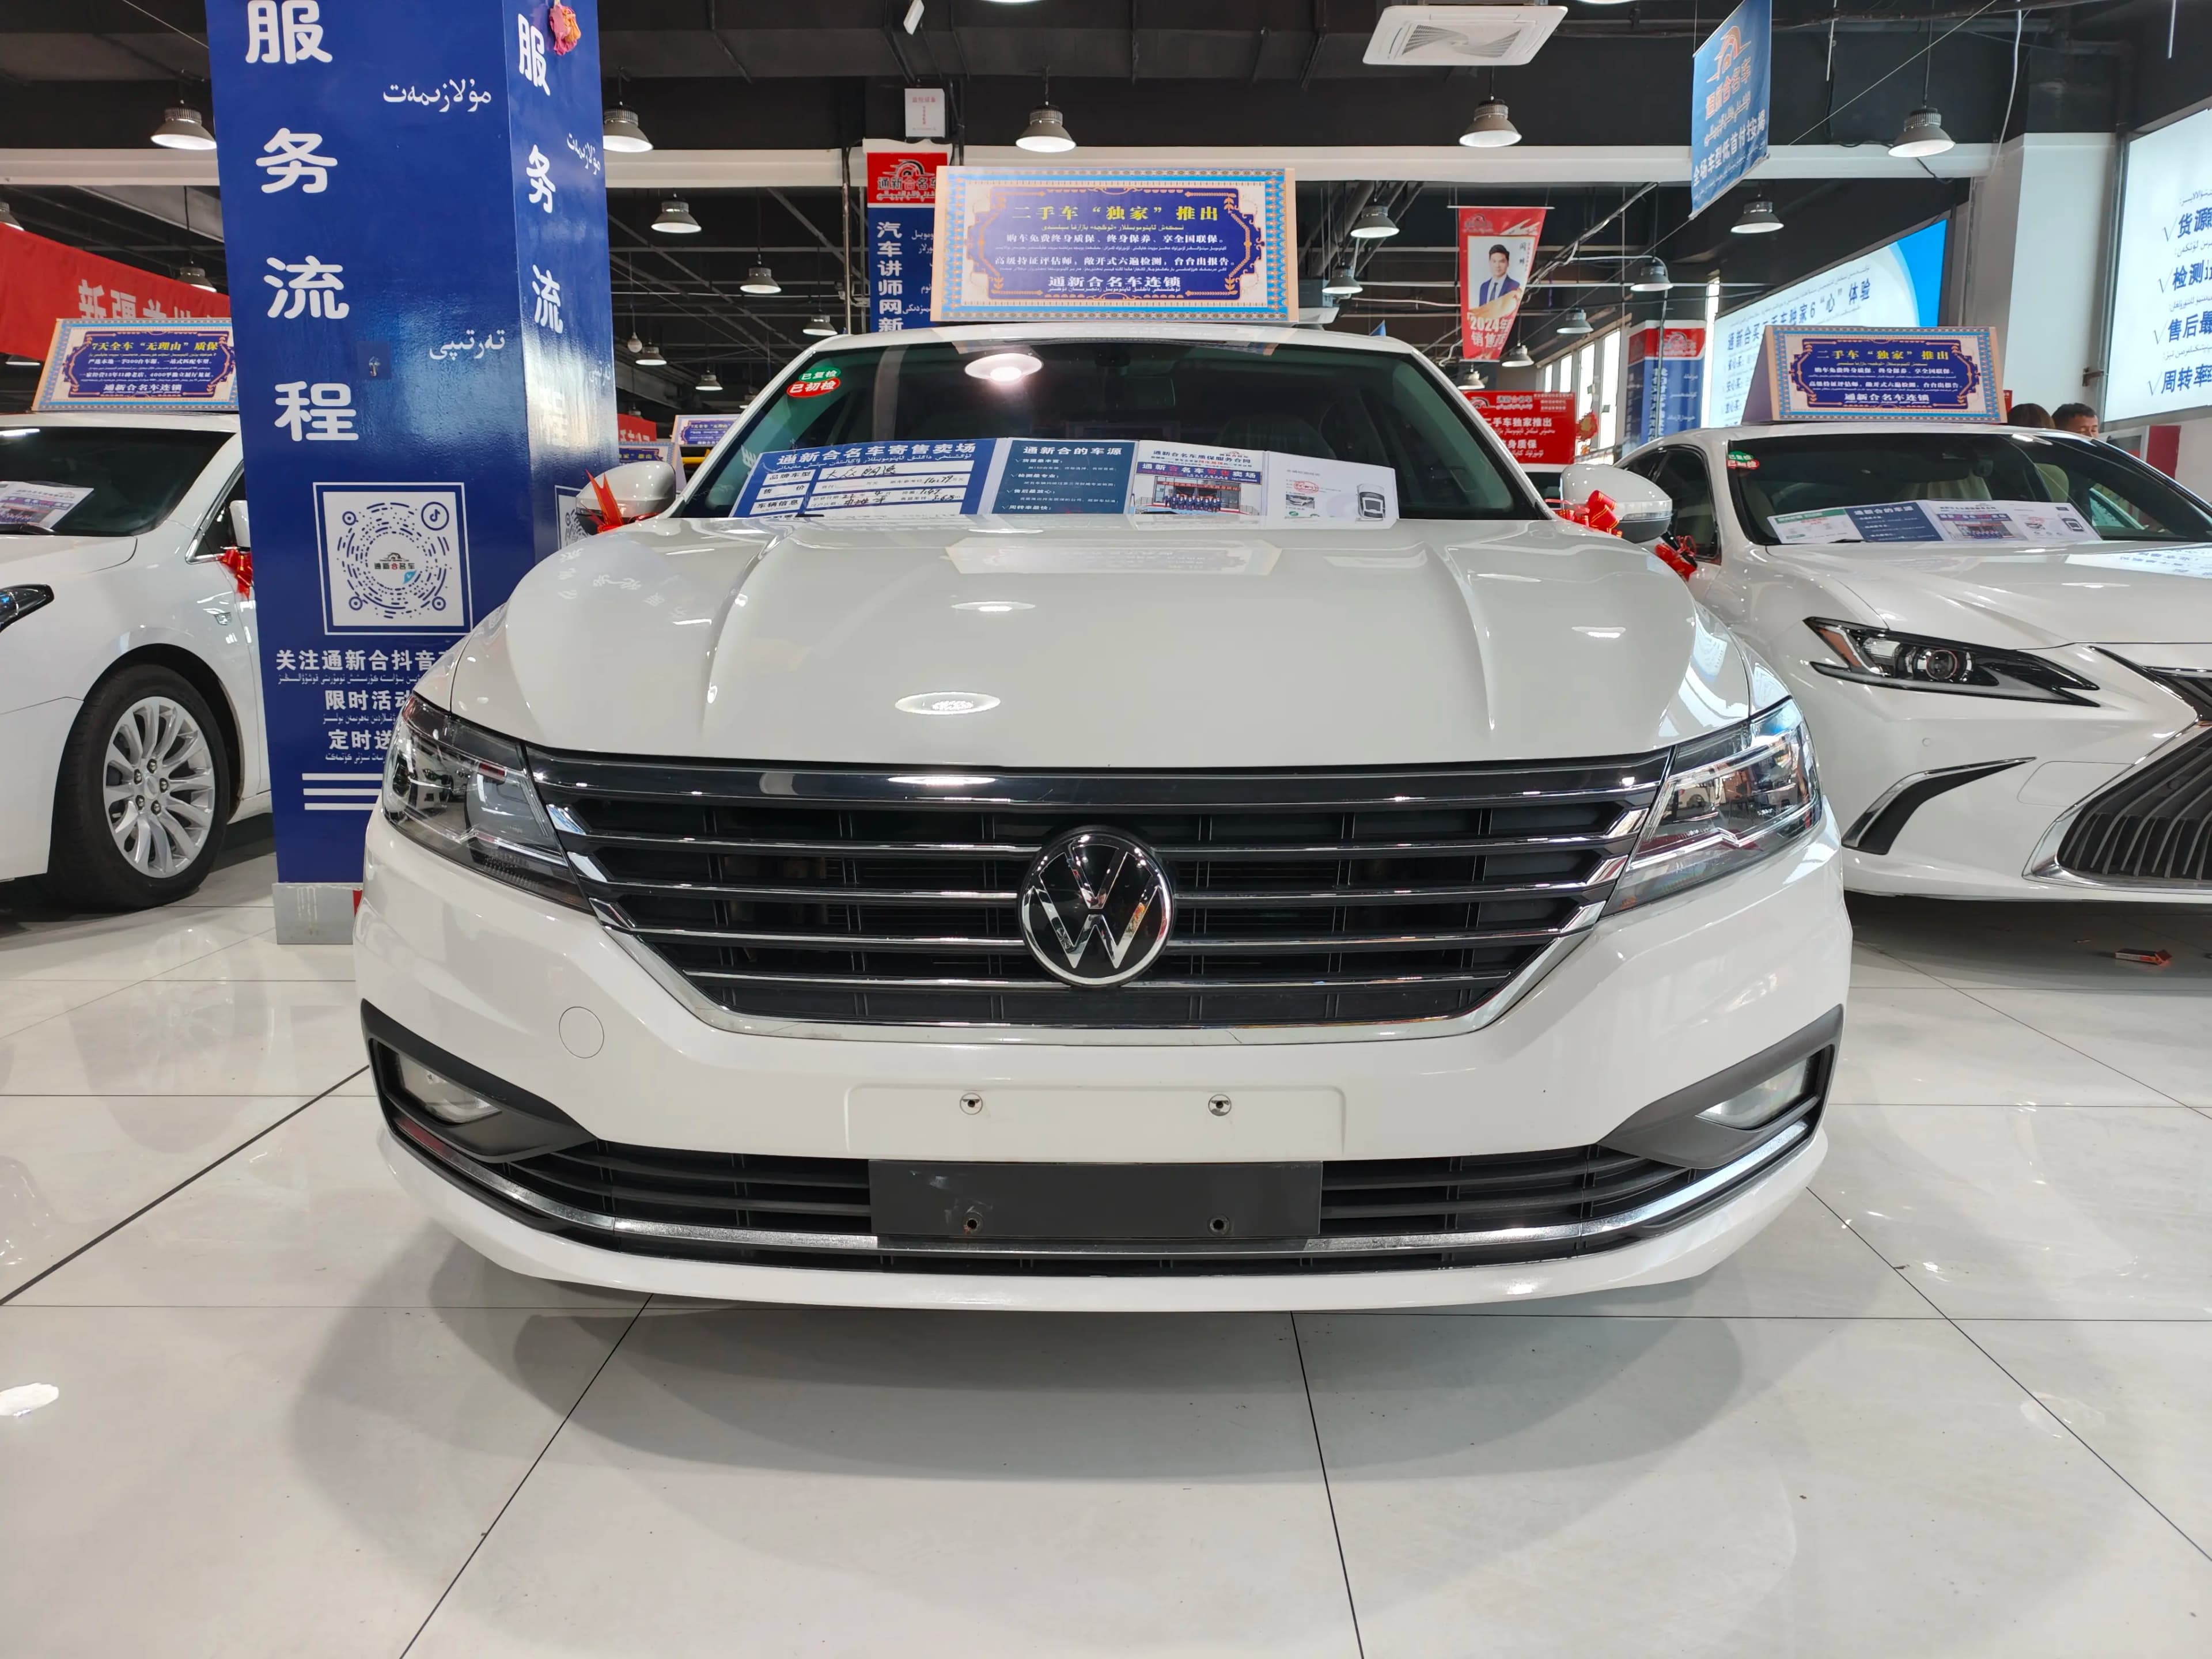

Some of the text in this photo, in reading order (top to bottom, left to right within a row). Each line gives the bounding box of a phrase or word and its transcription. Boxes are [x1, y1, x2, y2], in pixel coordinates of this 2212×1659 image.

[245, 0, 359, 441] 服务流程
[1048, 276, 1180, 287] 通新合名车连锁
[777, 443, 976, 465] 通新合名车寄售卖场
[1023, 446, 1123, 456] 通新合的车源
[276, 650, 450, 671] 关注通新合抖音
